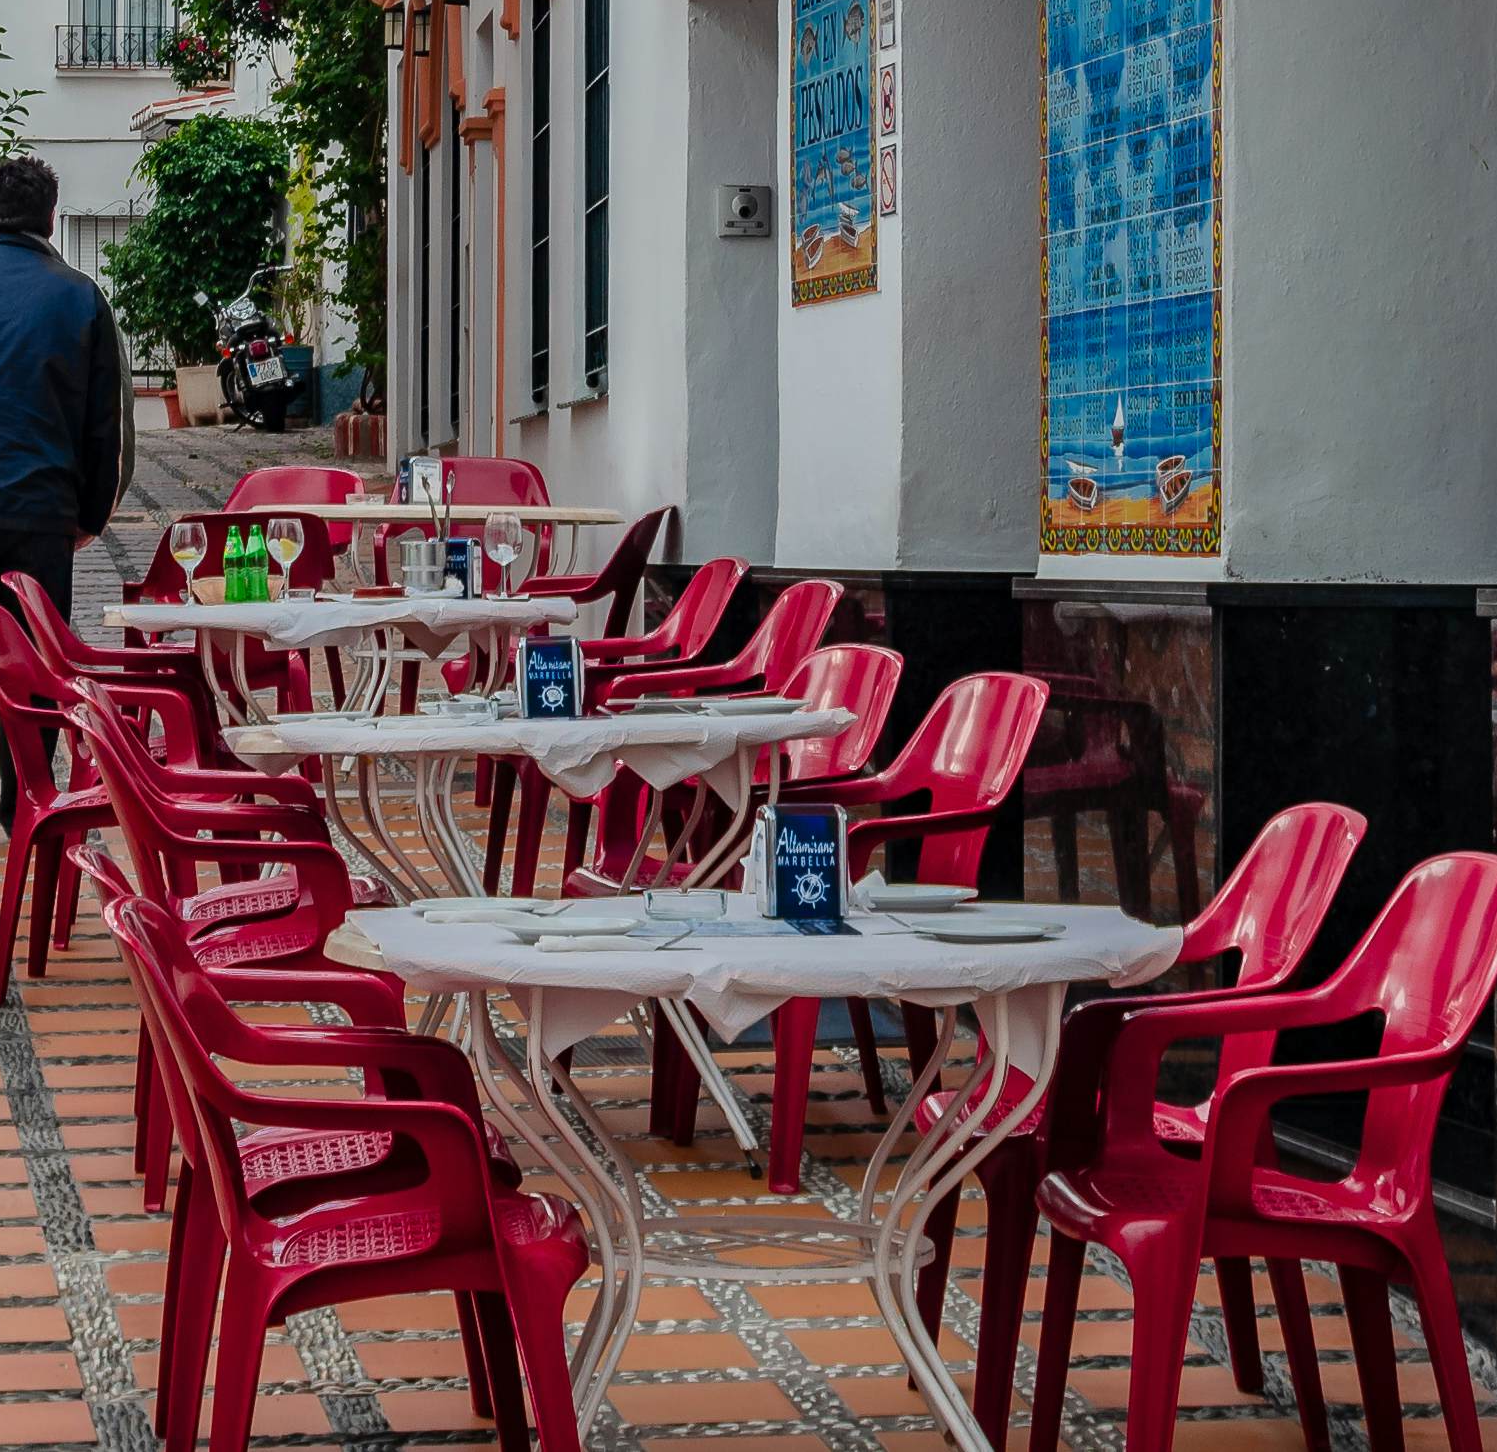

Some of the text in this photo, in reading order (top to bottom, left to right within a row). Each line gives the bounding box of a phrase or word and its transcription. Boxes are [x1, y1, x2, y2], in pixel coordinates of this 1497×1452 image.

[823, 11, 838, 62] EN
[800, 65, 863, 148] PESCADOS
[777, 855, 836, 867] MARBELLA
